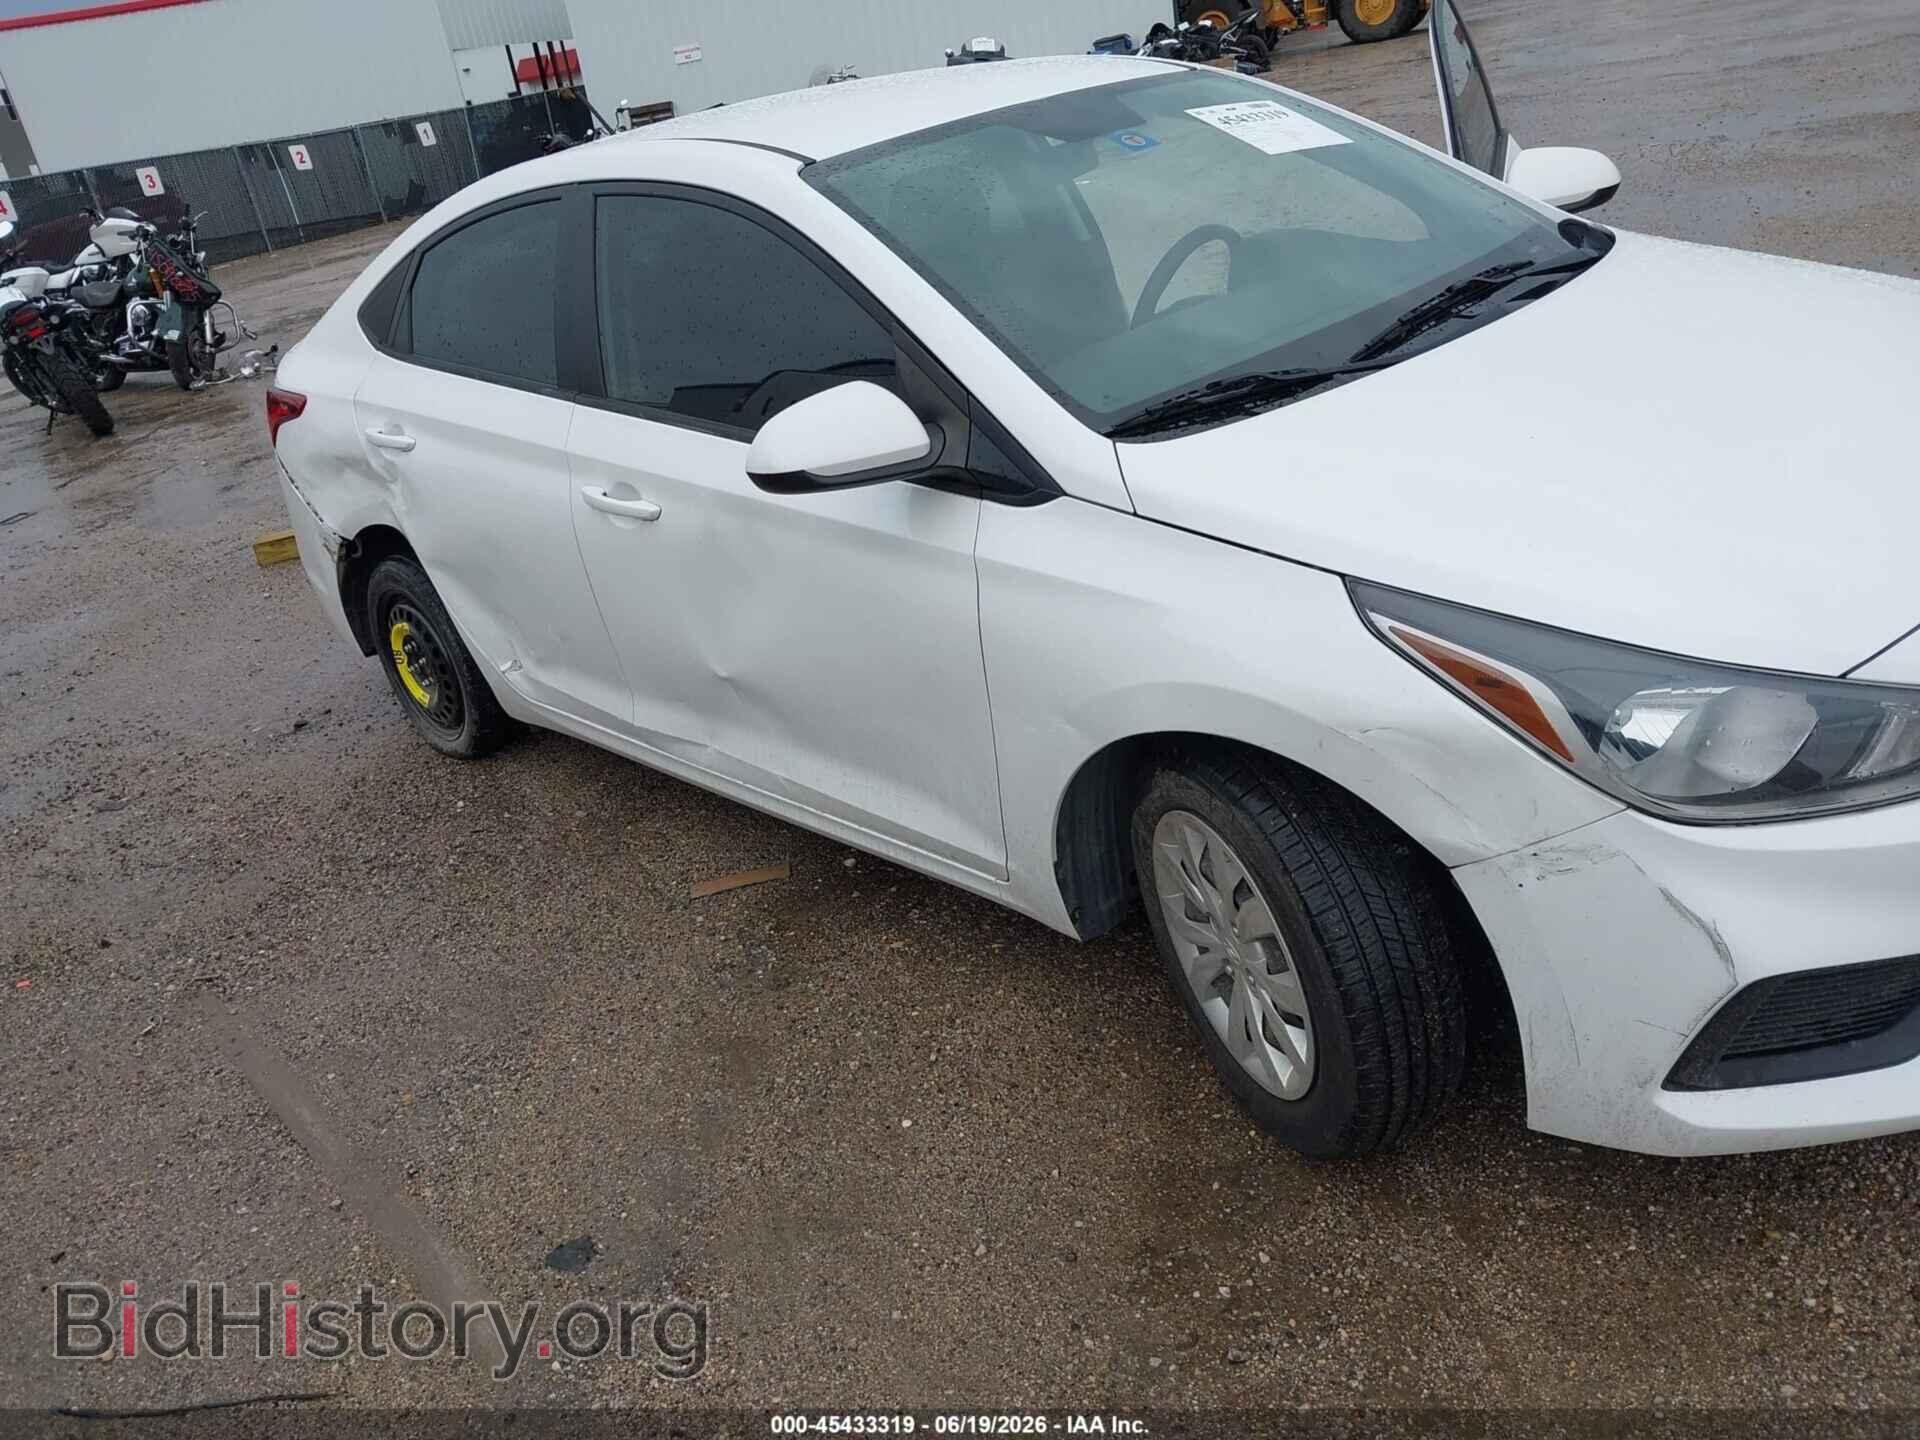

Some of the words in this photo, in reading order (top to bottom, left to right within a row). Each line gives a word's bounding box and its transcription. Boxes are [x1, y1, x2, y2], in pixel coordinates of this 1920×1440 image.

[422, 129, 430, 140] 1
[295, 151, 306, 164] 2
[144, 174, 157, 189] 3
